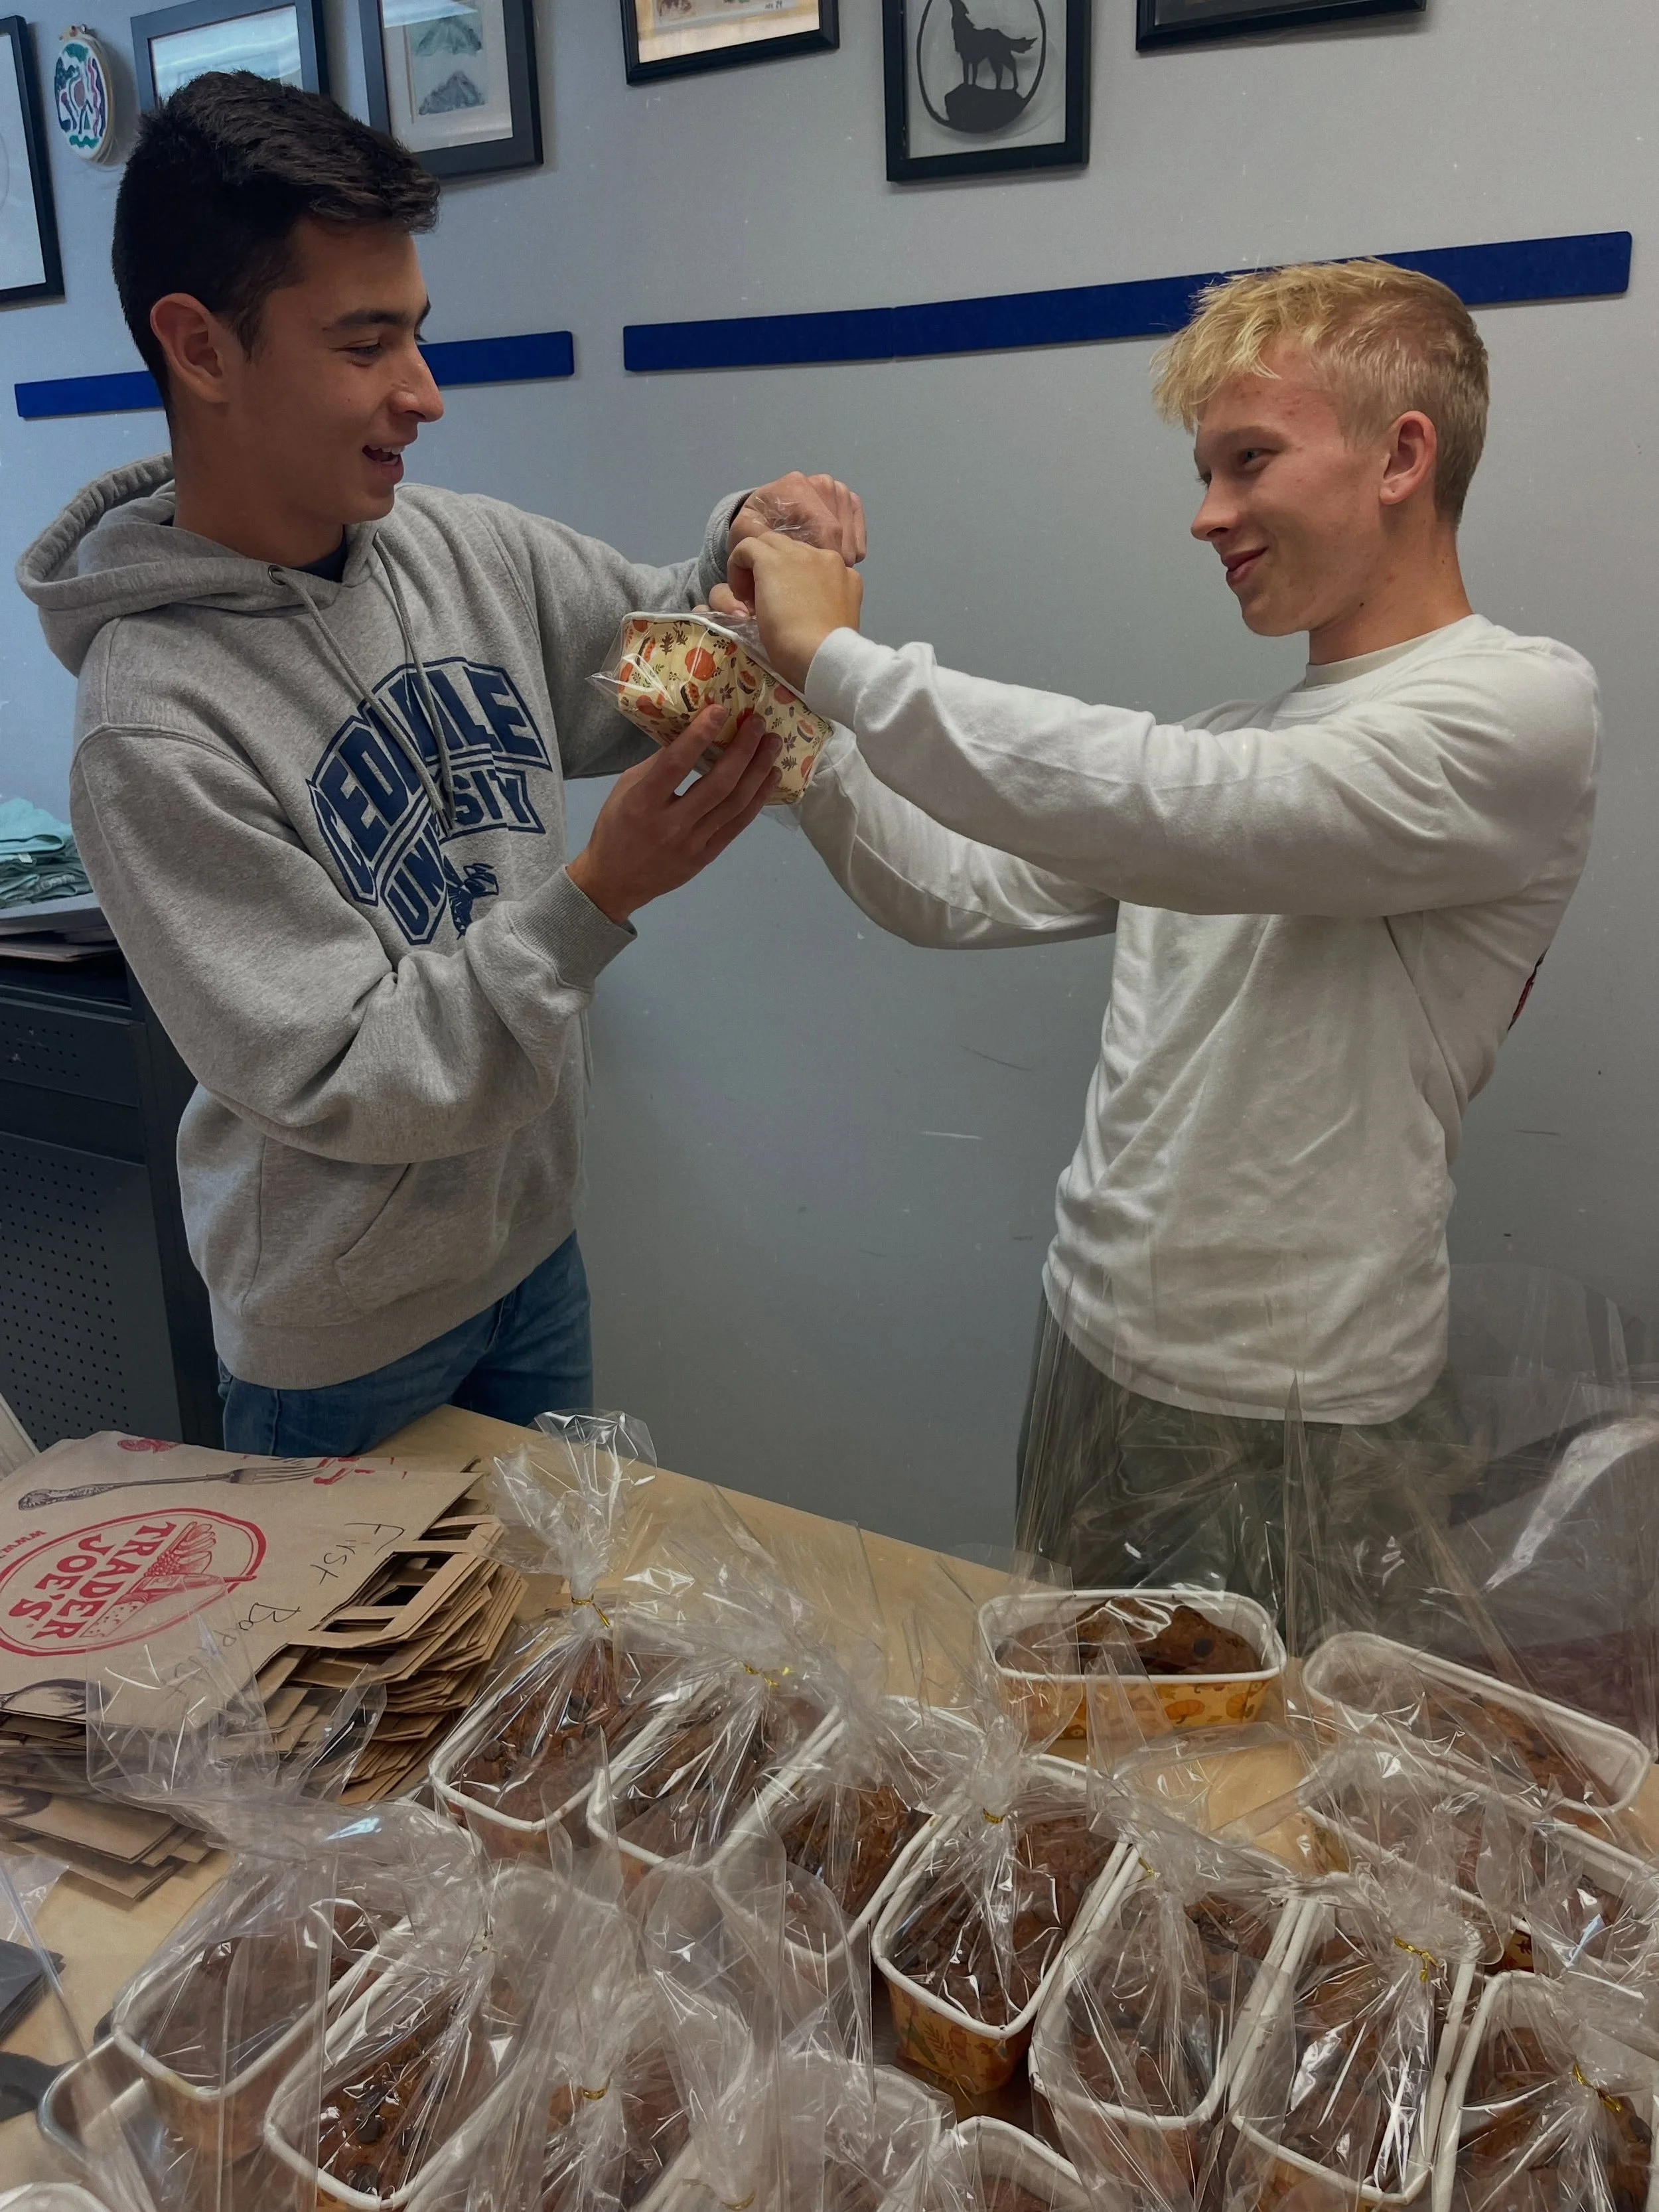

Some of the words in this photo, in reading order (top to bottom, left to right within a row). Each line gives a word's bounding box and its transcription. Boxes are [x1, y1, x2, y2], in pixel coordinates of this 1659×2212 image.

[8, 1533, 117, 1621] JOE'S
[31, 1521, 177, 1640] TRADER
[310, 1522, 405, 1585] First
